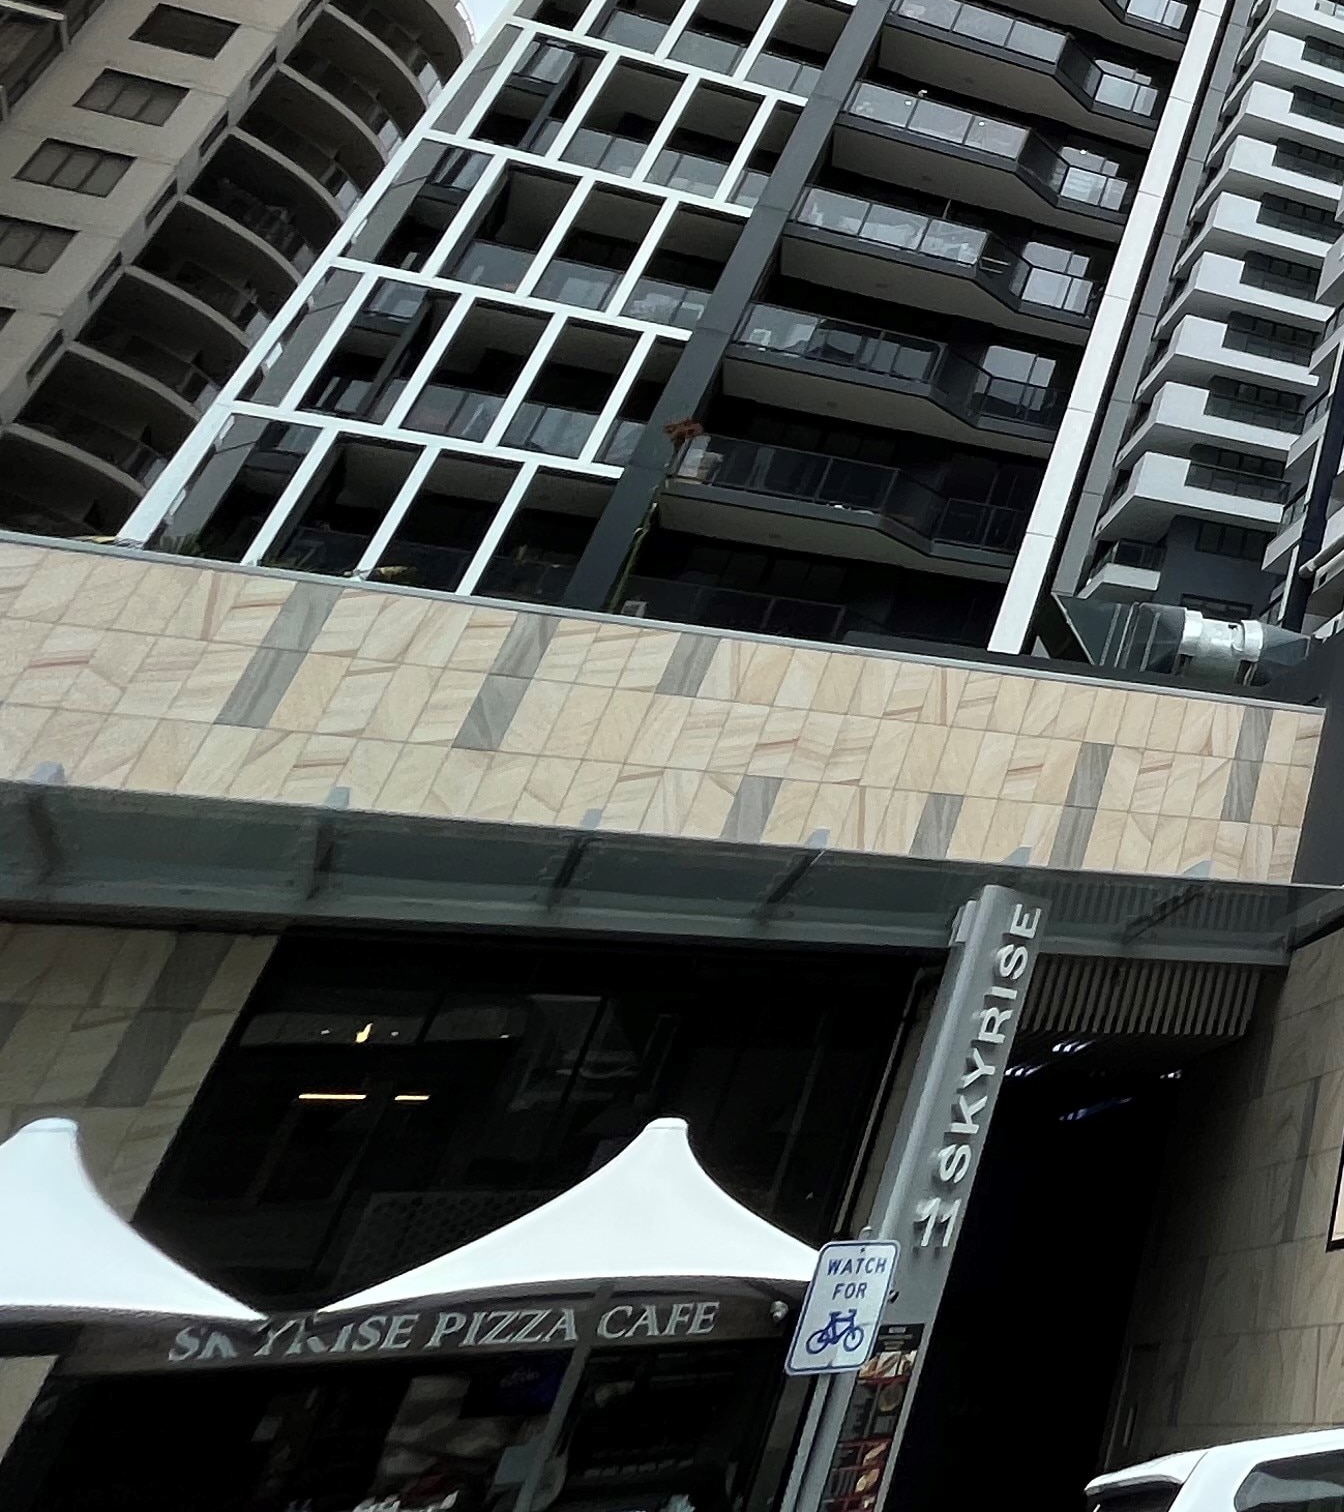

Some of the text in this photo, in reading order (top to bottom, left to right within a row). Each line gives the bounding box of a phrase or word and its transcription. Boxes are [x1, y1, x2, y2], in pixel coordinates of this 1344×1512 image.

[916, 903, 1042, 1248] 11 SKYRISE
[827, 1257, 888, 1276] WATCH
[831, 1281, 868, 1301] FOR
[424, 1308, 579, 1350] PIZZA
[596, 1300, 720, 1340] CAFE
